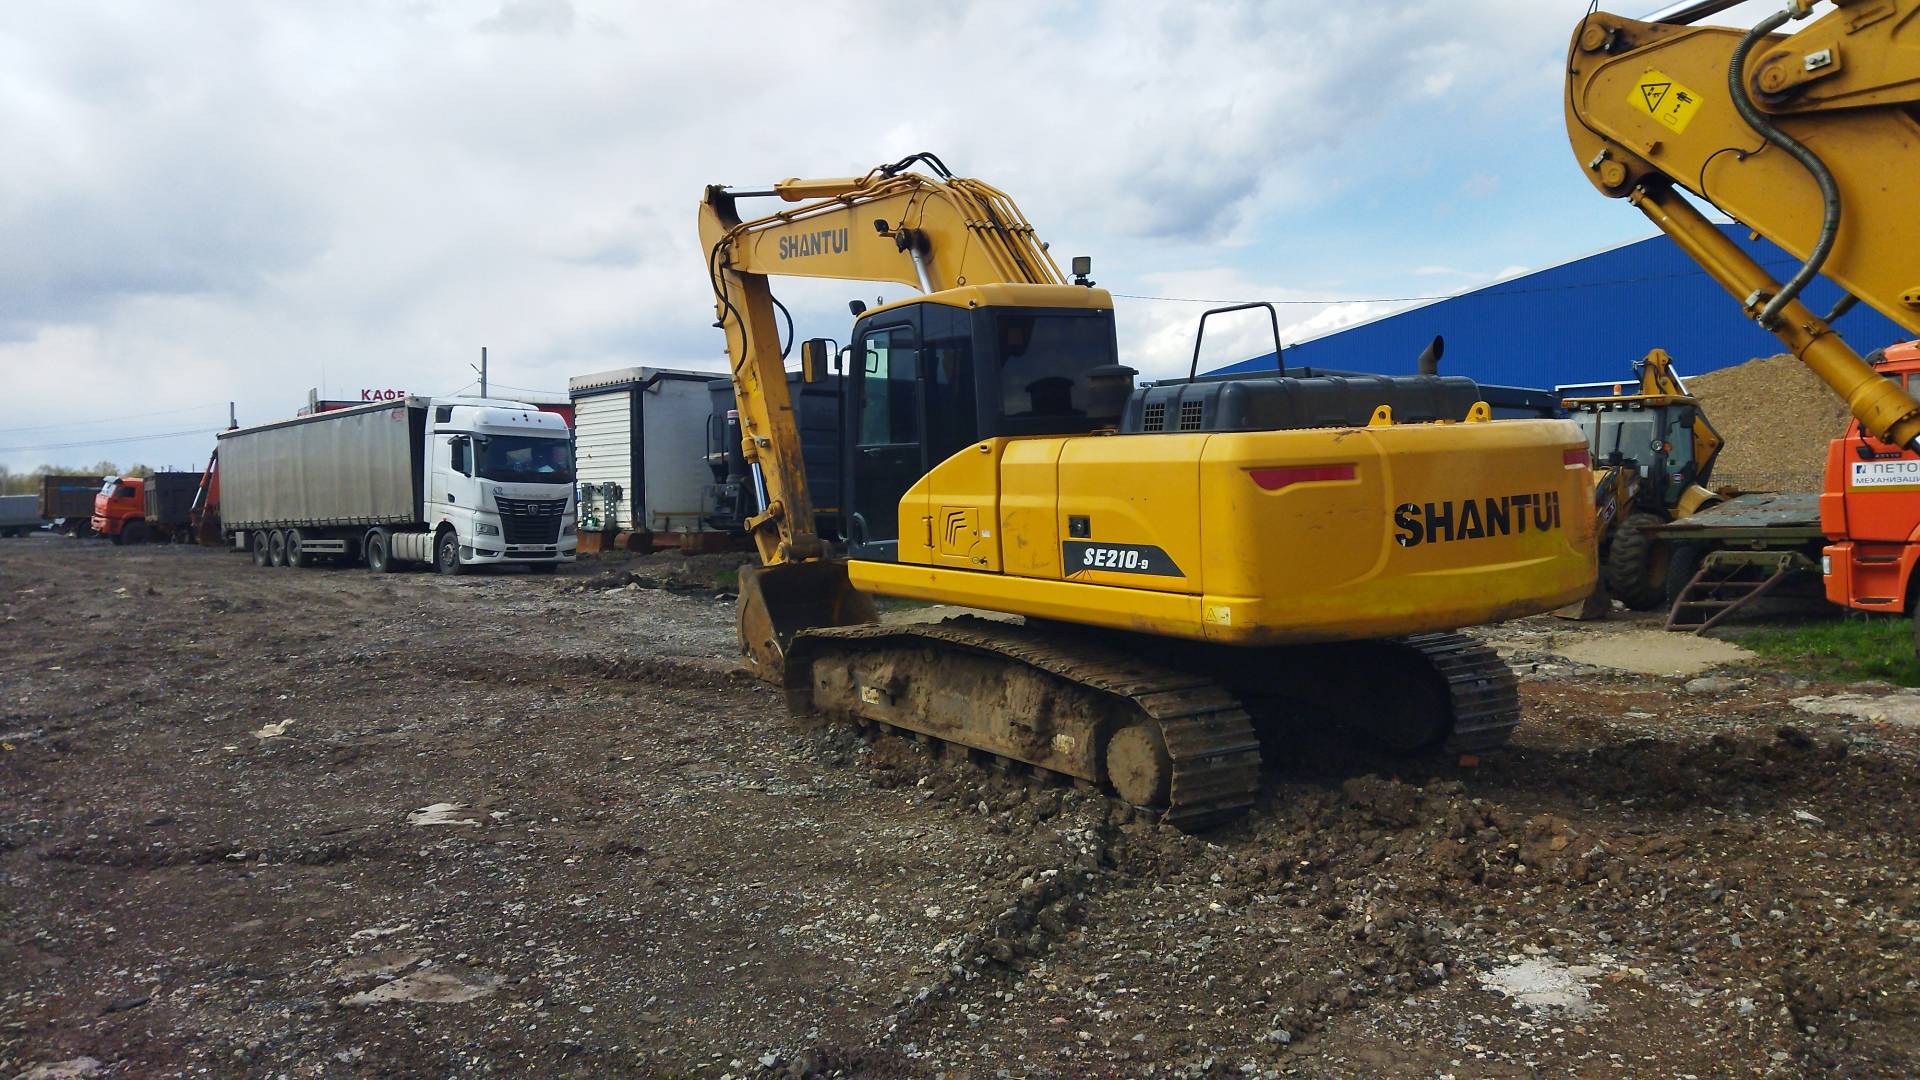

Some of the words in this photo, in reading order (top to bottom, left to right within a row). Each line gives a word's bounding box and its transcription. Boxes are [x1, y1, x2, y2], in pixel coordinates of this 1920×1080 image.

[779, 228, 849, 260] SHANTUI
[1873, 462, 1920, 474] ПЕТО
[1394, 491, 1561, 548] SHANTUI
[1083, 547, 1149, 570] SE210-9
